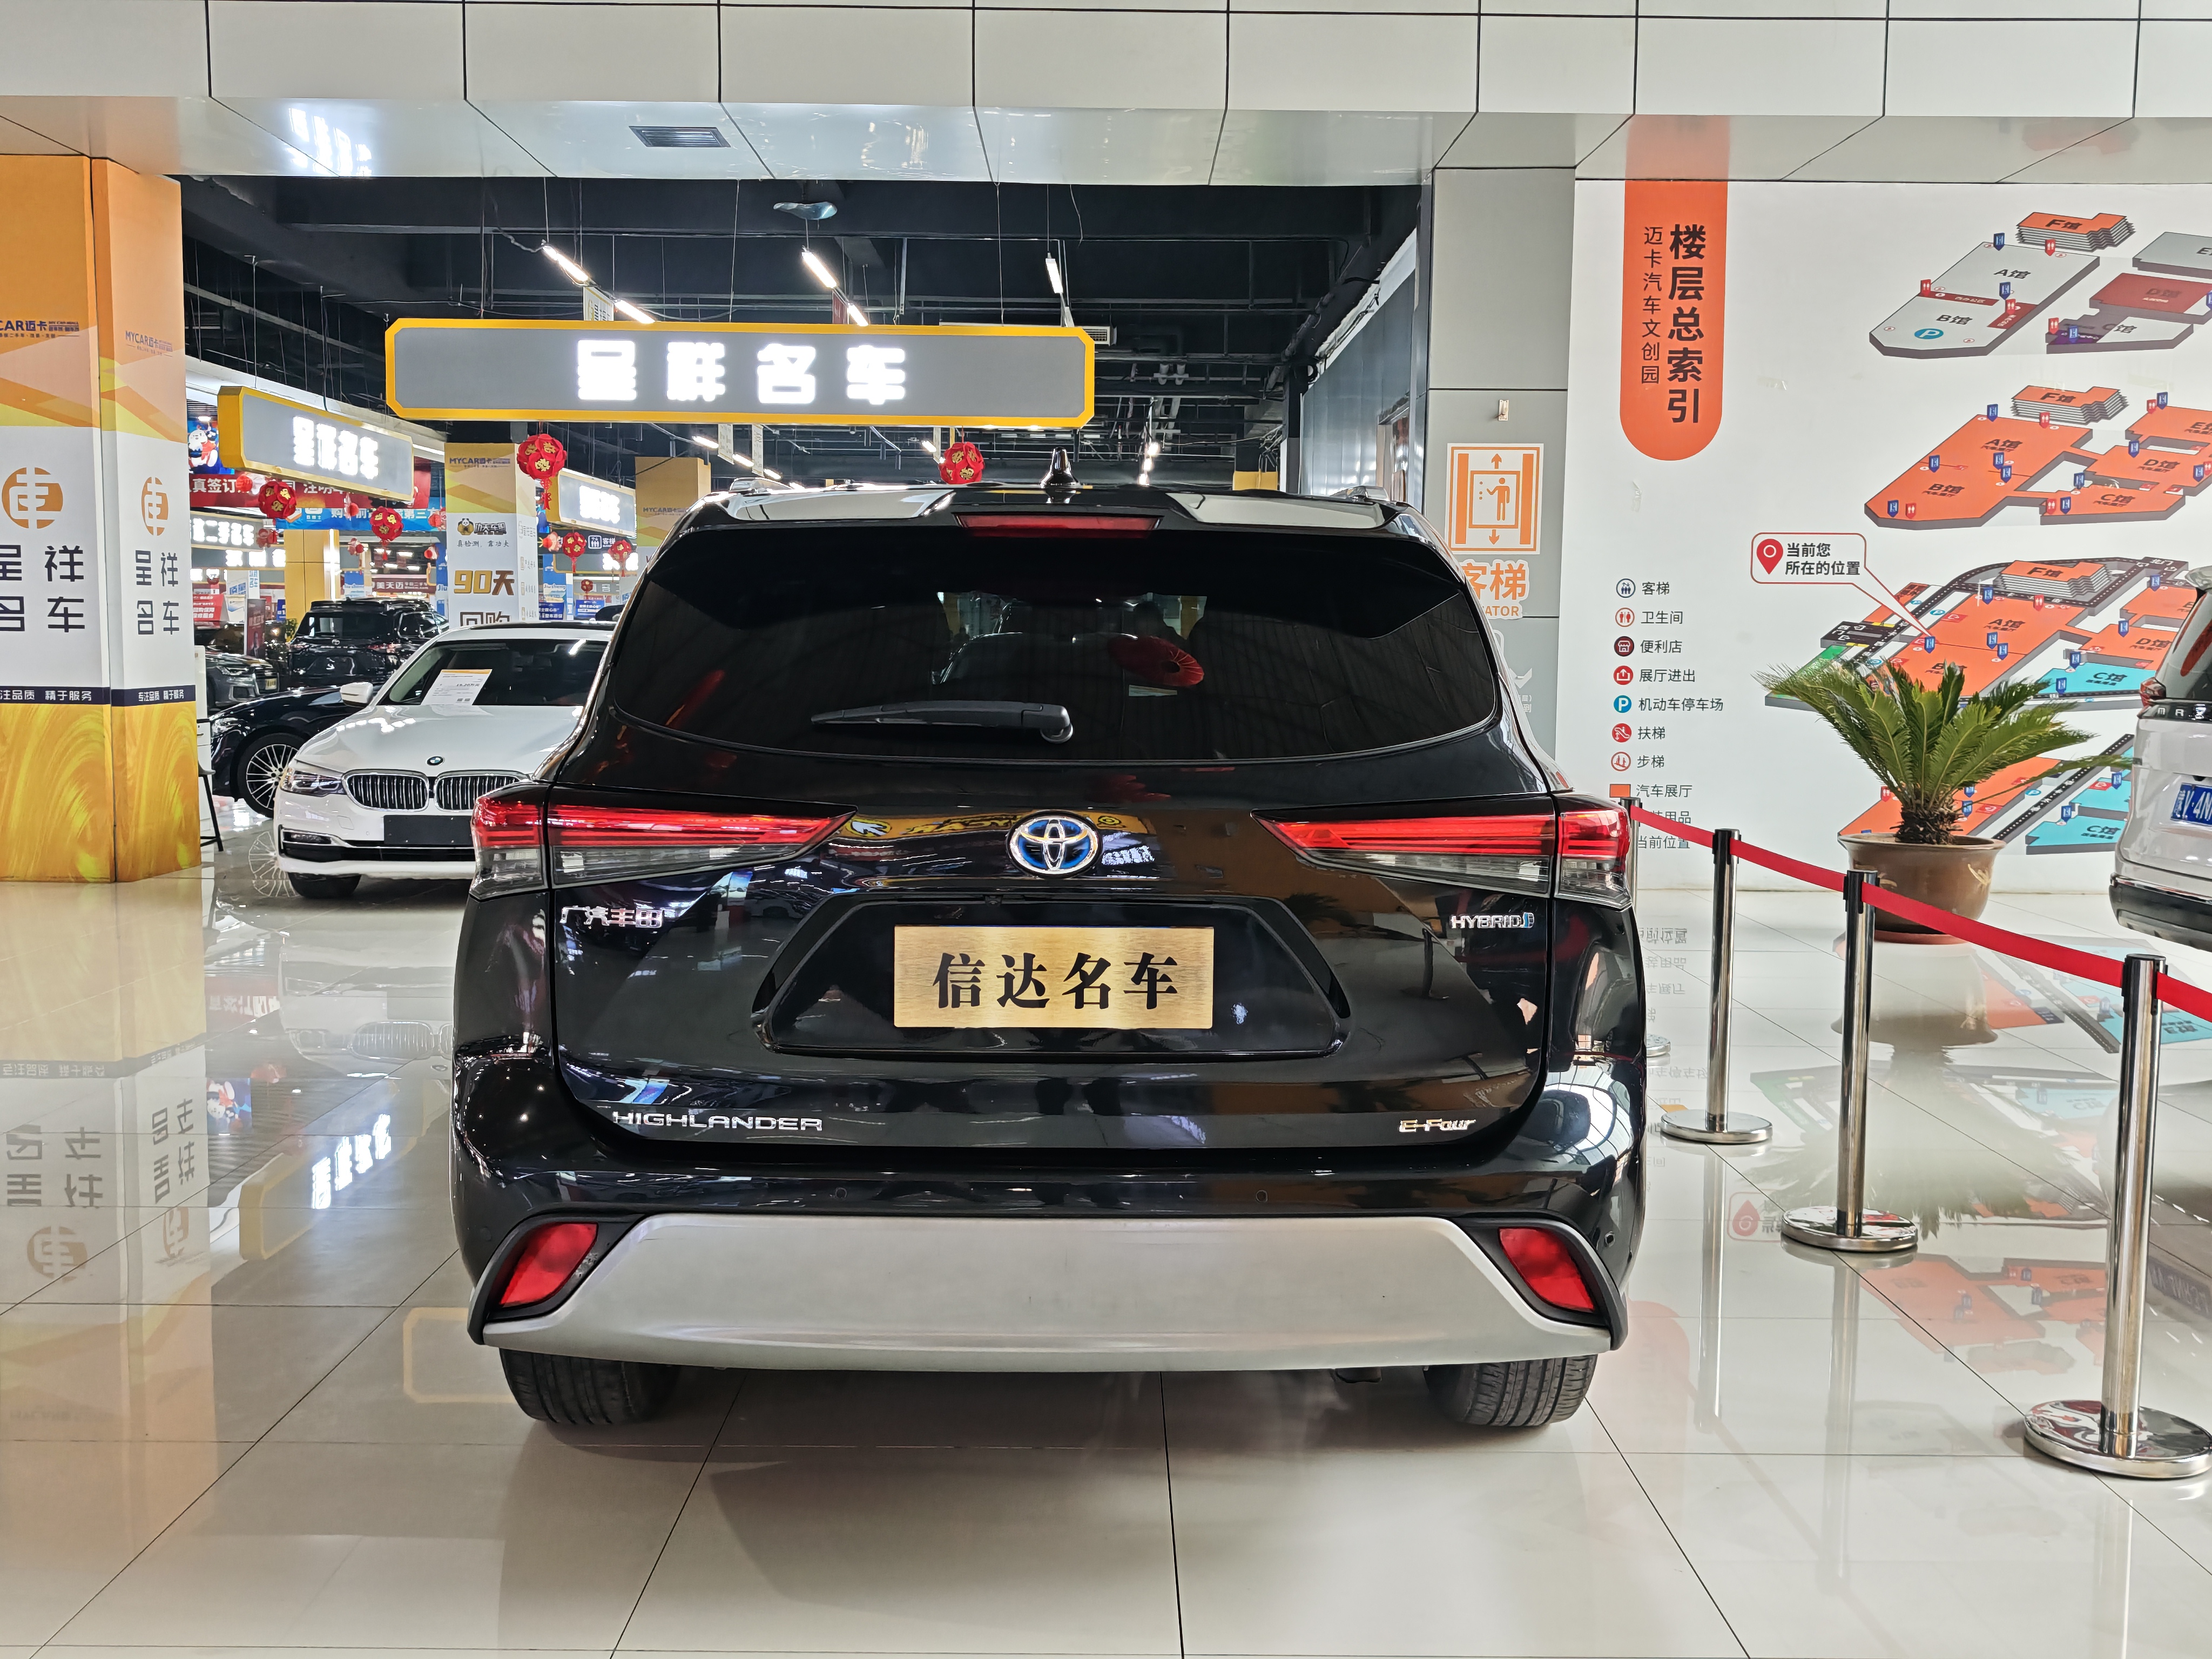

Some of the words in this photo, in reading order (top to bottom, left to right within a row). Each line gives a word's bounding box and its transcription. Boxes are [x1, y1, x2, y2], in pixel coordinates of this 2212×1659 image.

[2196, 247, 2212, 256] E
[1993, 269, 2031, 279] A馆
[1641, 227, 1663, 385] 迈卡汽车文创园
[1667, 224, 1706, 423] 楼层总索引
[1936, 315, 1973, 325] B馆
[1985, 439, 2023, 449] A馆
[1928, 483, 1965, 494] B馆
[1786, 543, 1831, 557] 当前您
[135, 550, 178, 587] 呈祥
[1785, 561, 1860, 575] 所在的位置
[454, 570, 515, 596] 90天
[1461, 563, 1526, 601] 客梯
[1642, 582, 1670, 595] 客梯
[137, 600, 179, 635] 名车
[1482, 605, 1519, 617] ATOR
[1641, 611, 1683, 624] 卫生间
[1988, 618, 2026, 629] A馆
[1640, 640, 1683, 653] 便利店
[1639, 669, 1696, 682] 展厅进出
[45, 690, 92, 701] 精于服务
[138, 691, 160, 702] 专注品质
[1638, 698, 1724, 712] 机动车停车场
[1637, 726, 1665, 740] 扶梯
[1637, 755, 1665, 768] 步梯
[1636, 784, 1692, 798] 汽车展厅
[1638, 835, 1690, 849] 当前位置
[559, 905, 664, 928] 广汽丰田
[1451, 914, 1522, 929] HYBRID
[933, 952, 1178, 1010] 信达名车
[612, 1111, 822, 1131] HIGHLANDER
[1398, 1118, 1476, 1132] E-Four
